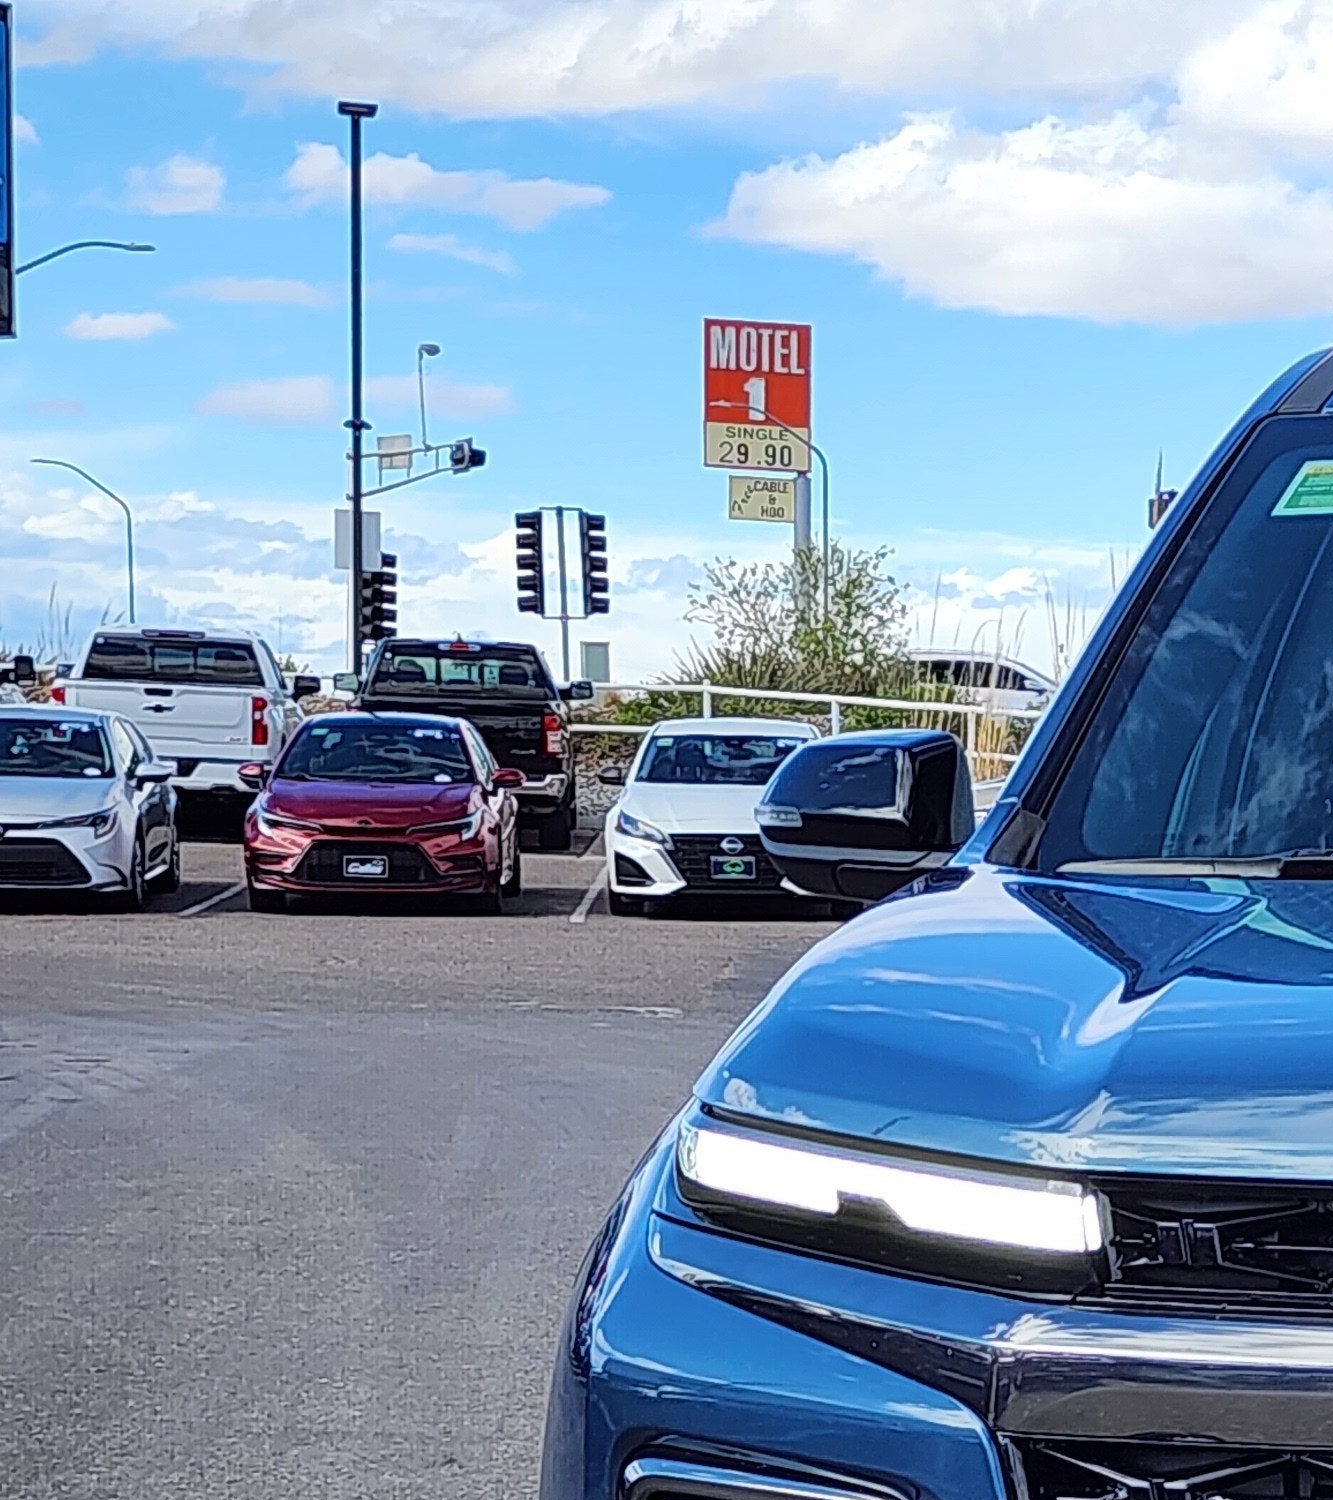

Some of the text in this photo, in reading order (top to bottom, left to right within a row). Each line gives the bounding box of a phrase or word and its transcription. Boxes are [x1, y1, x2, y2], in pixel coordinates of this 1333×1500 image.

[709, 325, 806, 375] MOTEL
[743, 377, 767, 421] 1
[725, 426, 790, 441] SINGLE
[753, 481, 790, 494] CABLE
